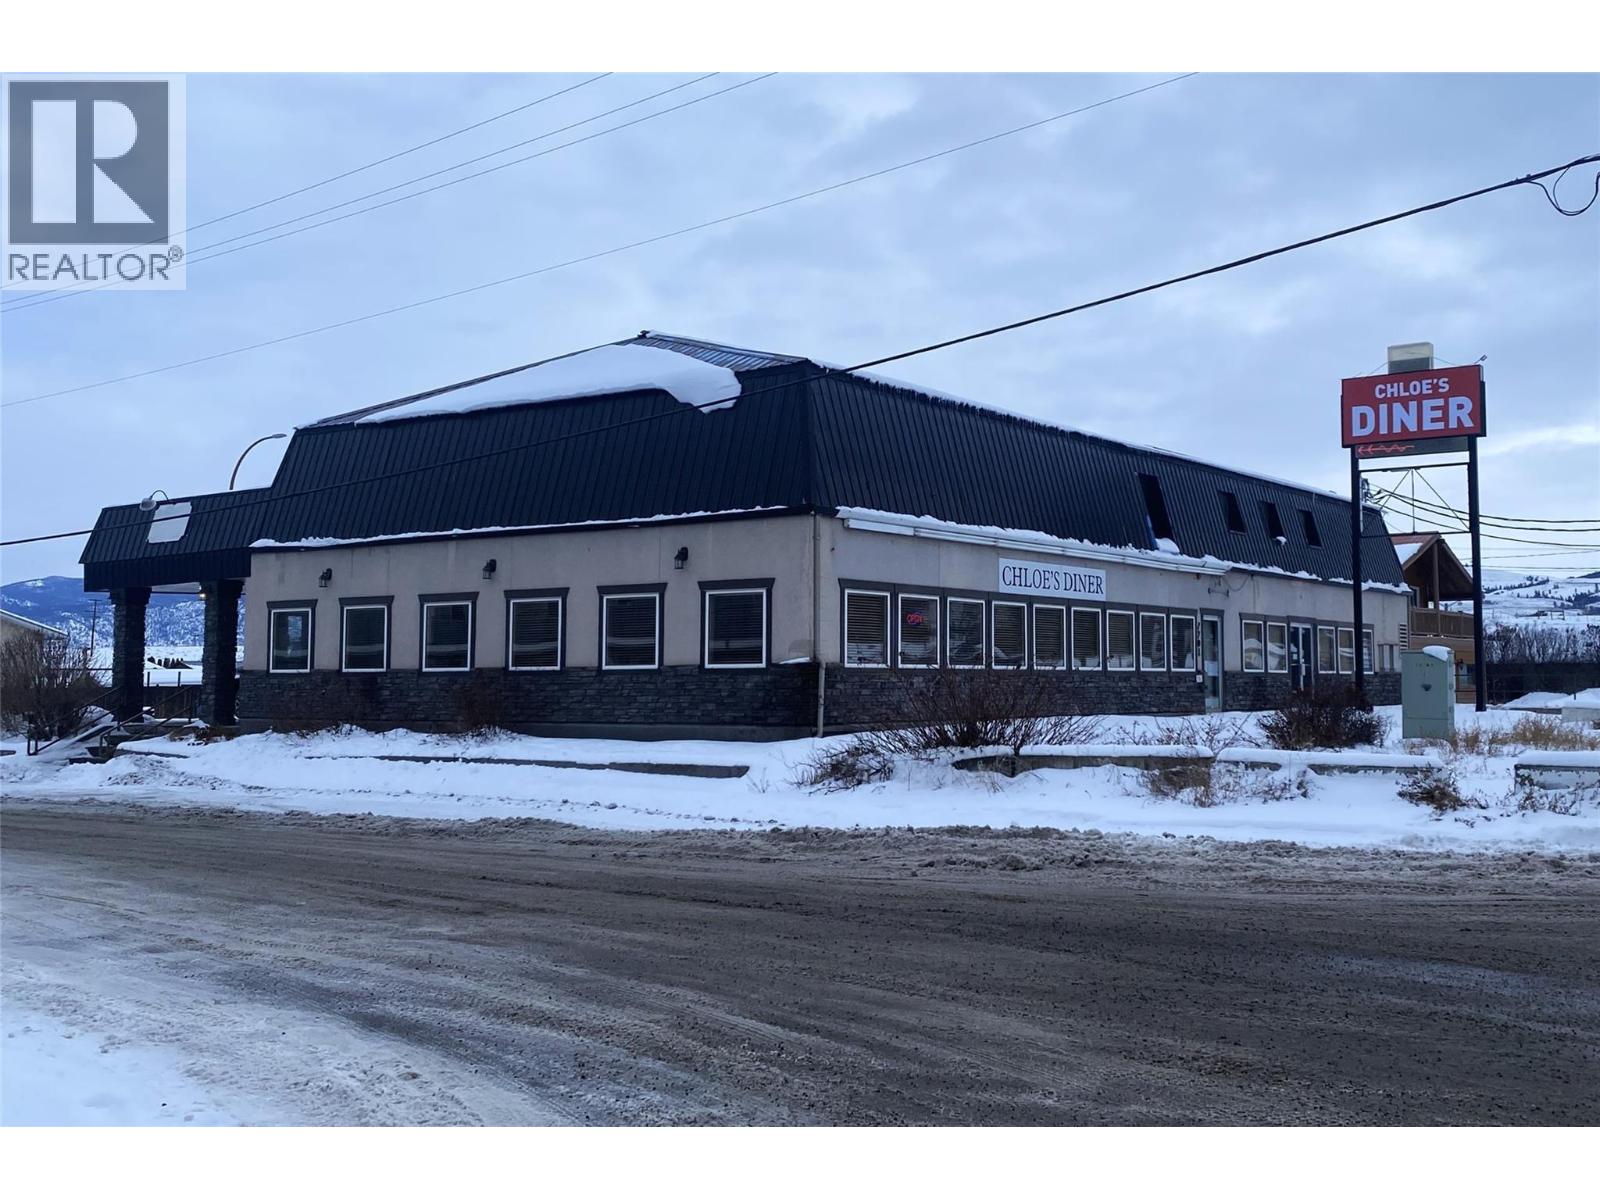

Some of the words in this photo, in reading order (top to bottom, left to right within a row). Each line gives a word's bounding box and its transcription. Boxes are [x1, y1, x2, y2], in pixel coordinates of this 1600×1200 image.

[1375, 378, 1449, 398] CHLOE'S
[1352, 396, 1473, 437] DINER
[1002, 565, 1061, 591] CHLOE'S
[1064, 573, 1104, 595] DINER
